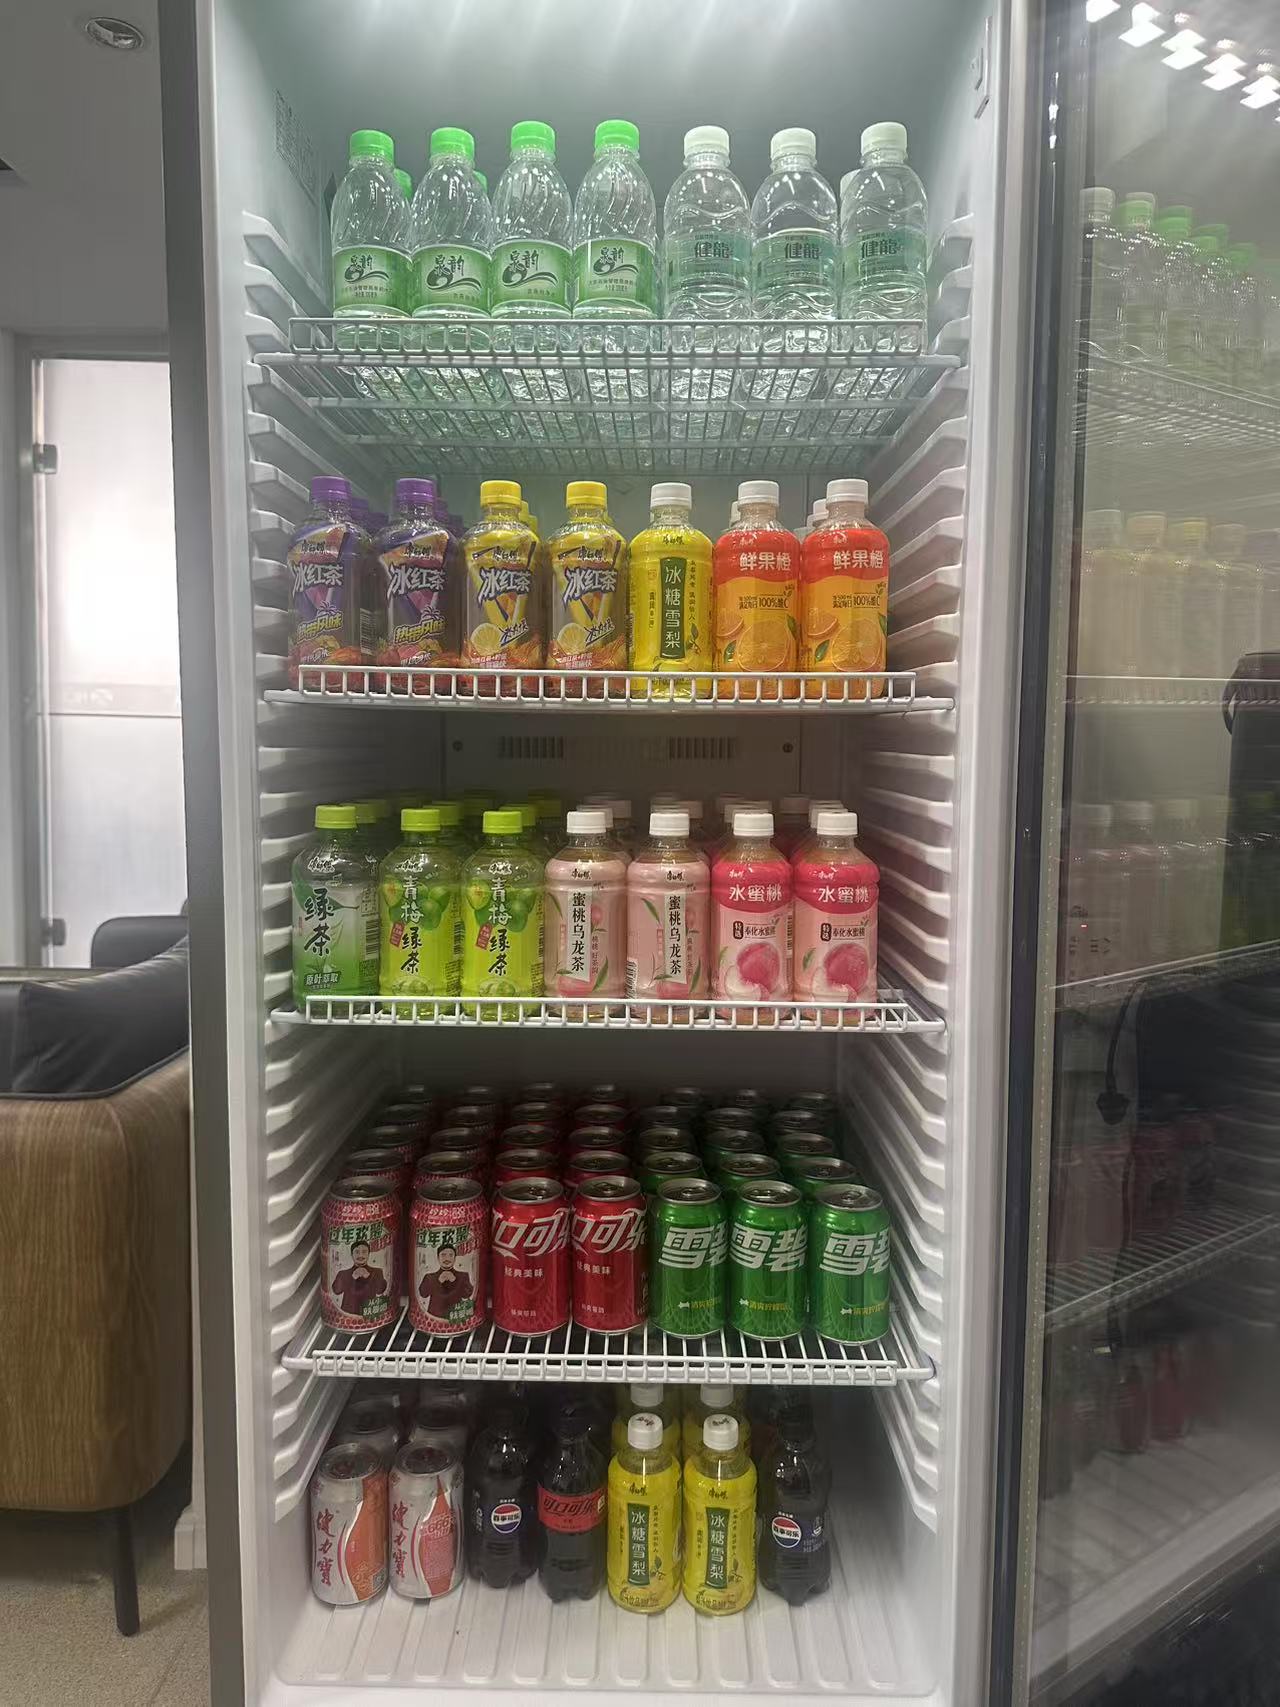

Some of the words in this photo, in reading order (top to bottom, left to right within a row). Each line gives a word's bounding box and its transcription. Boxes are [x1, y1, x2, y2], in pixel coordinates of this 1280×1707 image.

[738, 551, 792, 572] 鲜果橙
[833, 550, 885, 571] 鲜果橙
[292, 564, 344, 598] 冰红茶
[387, 566, 446, 600] 冰红茶
[479, 568, 532, 604] 冰红茶
[563, 568, 617, 604] 冰红茶
[664, 565, 682, 649] 冰糖雪梨
[728, 884, 782, 902] 水蜜桃
[818, 886, 869, 903] 水蜜桃
[304, 888, 335, 956] 绿茶
[400, 875, 424, 975] 青梅绿茶
[488, 877, 512, 976] 青梅绿茶
[571, 892, 587, 972] 蜜桃乌龙茶
[668, 895, 682, 975] 蜜桃乌龙茶
[730, 1223, 808, 1272] 雪碧
[504, 1265, 544, 1278] 经典美味
[428, 1516, 450, 1534] 666
[544, 1497, 593, 1517] 可口可乐
[631, 1511, 647, 1577] 冰糖雪梨
[710, 1514, 726, 1579] 冰糖雪梨
